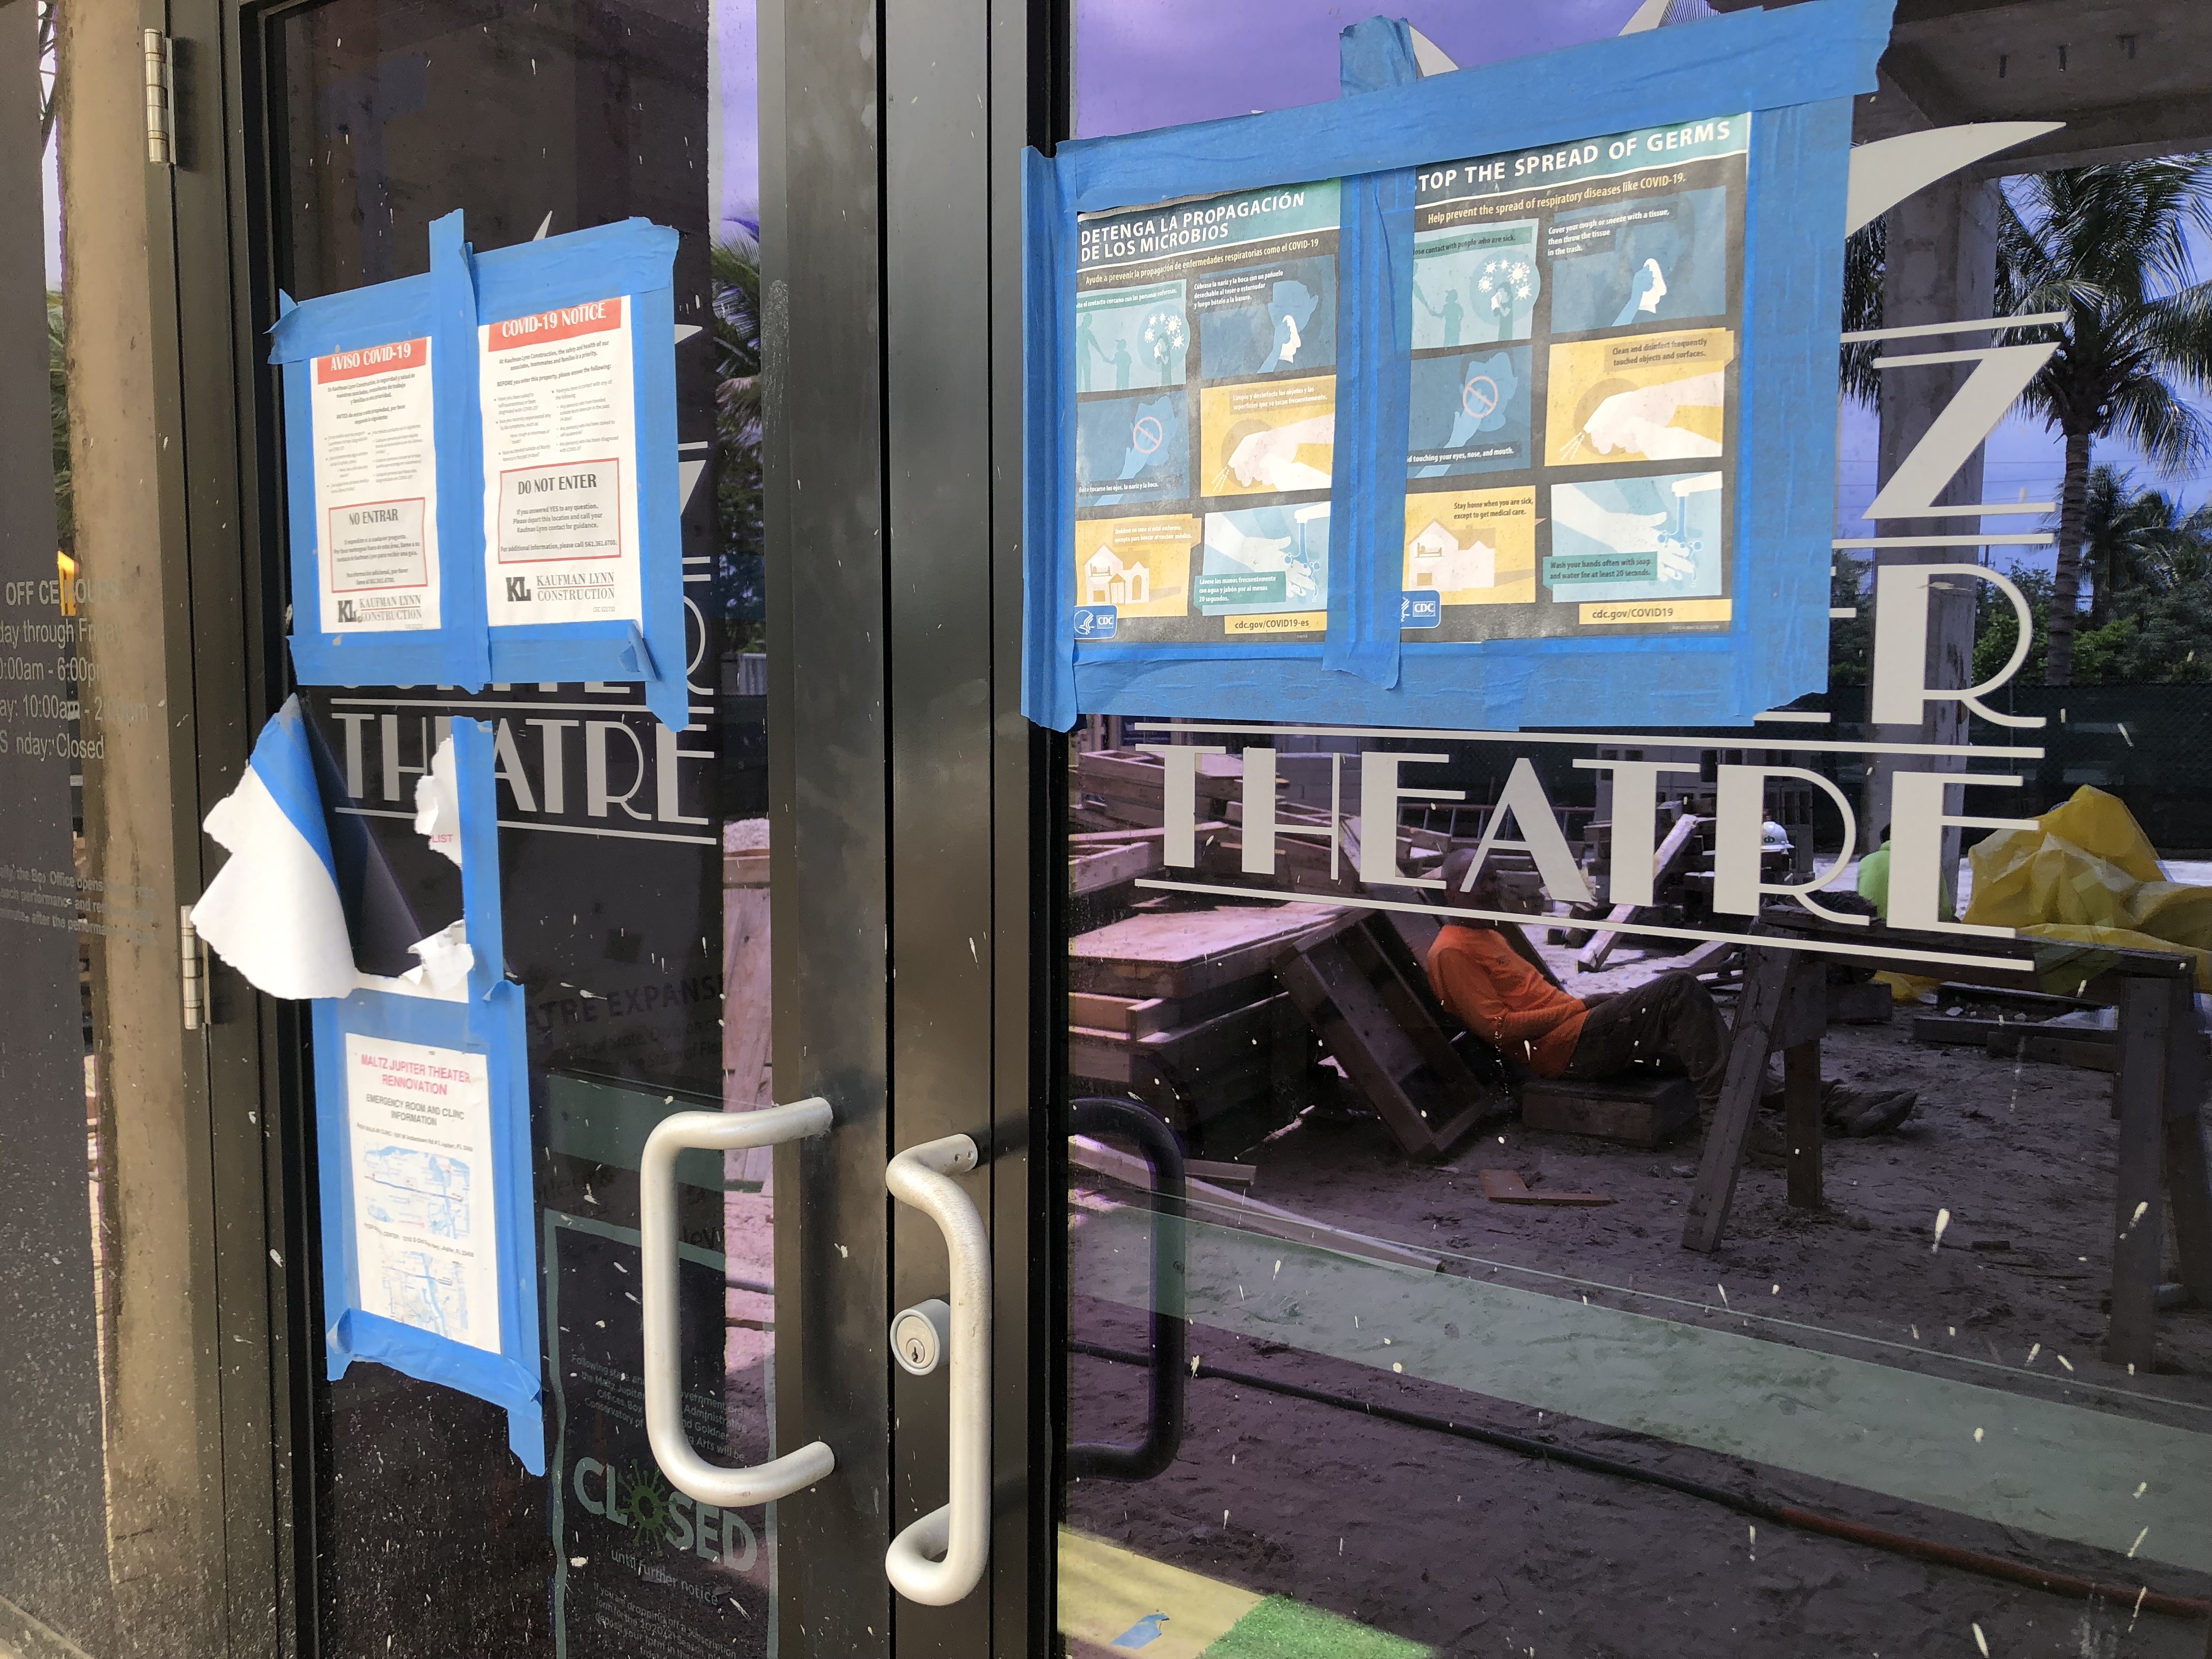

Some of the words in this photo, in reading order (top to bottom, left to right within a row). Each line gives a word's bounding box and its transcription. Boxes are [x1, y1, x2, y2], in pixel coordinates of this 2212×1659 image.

[1418, 170, 1457, 191] TOP
[1464, 162, 1505, 184] THE
[1515, 145, 1599, 176] SPREAD
[1609, 137, 1637, 160] OF
[1647, 121, 1730, 153] GERMS
[1428, 212, 1445, 225] Help
[1446, 206, 1477, 224] prevent
[1479, 204, 1493, 216] the
[1495, 198, 1524, 215] spread
[1526, 196, 1536, 208] of
[1537, 191, 1582, 207] respiratory
[1583, 185, 1621, 199] diseases
[1622, 180, 1639, 193] like
[1640, 173, 1686, 190] COVID-19.
[1081, 220, 1155, 245] DETENGA
[1160, 217, 1178, 233] LA
[1183, 191, 1305, 228] PROPAGACIÓN
[1564, 224, 1578, 234] your
[1579, 219, 1596, 229] cough
[1606, 216, 1626, 225] sneeze
[1627, 212, 1642, 221] with
[1081, 244, 1099, 262] DE
[1105, 239, 1136, 258] LOS
[1140, 222, 1229, 252] MICROBIOS
[1425, 245, 1445, 253] contact
[1458, 240, 1476, 250] people
[1548, 237, 1562, 245] then
[1566, 244, 1583, 253] trash.
[1086, 274, 1103, 285] Ayude
[1109, 269, 1133, 282] prevenir
[1135, 268, 1139, 276] la
[1140, 262, 1173, 277] propagación
[1175, 261, 1181, 270] de
[1182, 255, 1223, 268] enfermedades
[1224, 249, 1262, 262] respiratorias
[1263, 246, 1280, 255] como
[1282, 244, 1287, 252] el
[1288, 238, 1319, 251] COVID-19
[1265, 270, 1283, 280] pañuelo
[1194, 290, 1219, 299] desechable
[1240, 283, 1266, 292] estornudar
[502, 313, 557, 337] COVID-19
[562, 302, 606, 326] NOTICE
[330, 353, 360, 371] AVISO
[363, 343, 411, 366] COVID-19
[1612, 347, 1629, 356] Clean
[1630, 345, 1642, 353] and
[1643, 342, 1671, 352] disinfect
[1672, 338, 1707, 349] frequently
[1613, 356, 1638, 366] touched
[1639, 354, 1661, 364] objects
[1676, 351, 1706, 359] surfaces.
[1413, 454, 1438, 462] touching
[1482, 448, 1493, 456] and
[1494, 447, 1514, 455] mouth.
[518, 480, 531, 494] DO
[534, 478, 555, 493] NOT
[558, 474, 597, 490] ENTER
[1454, 502, 1466, 510] Stay
[1454, 511, 1472, 520] except
[1480, 510, 1489, 519] get
[1490, 509, 1511, 517] medical
[349, 512, 360, 525] NO
[363, 509, 398, 524] ENTRAR
[535, 573, 586, 586] KAUFMAN
[589, 572, 614, 584] LYNN
[505, 577, 532, 602] KL
[538, 588, 615, 601] CONSTRUCTION
[337, 600, 357, 623] KL
[359, 596, 397, 608] KAUFMAN
[399, 595, 421, 605] LYNN
[1414, 603, 1434, 612] CDC
[361, 610, 422, 622] CONSTRUCTION
[1098, 617, 1113, 625] CDC
[1592, 608, 1673, 620] cdc.gov/COVID19
[23, 618, 74, 648] through
[1235, 619, 1309, 630] cdc.gov/COVID19-es
[57, 733, 104, 759] Closed
[331, 713, 714, 825] THATRE
[1136, 746, 2040, 939] THEATRE
[607, 975, 723, 1017] EXPANS
[361, 1054, 388, 1069] MALTZ
[390, 1059, 425, 1076] JUPITER
[428, 1065, 471, 1083] THEATER
[382, 1074, 447, 1095] RENNOVATION
[366, 1094, 404, 1108] EMERGENCY
[405, 1101, 425, 1113] ROOM
[427, 1105, 440, 1115] AND
[391, 1110, 437, 1126] INFORMATION
[574, 1457, 758, 1572] CLOSED
[611, 1549, 636, 1570] until
[639, 1560, 678, 1588] further
[681, 1579, 718, 1606] notice
